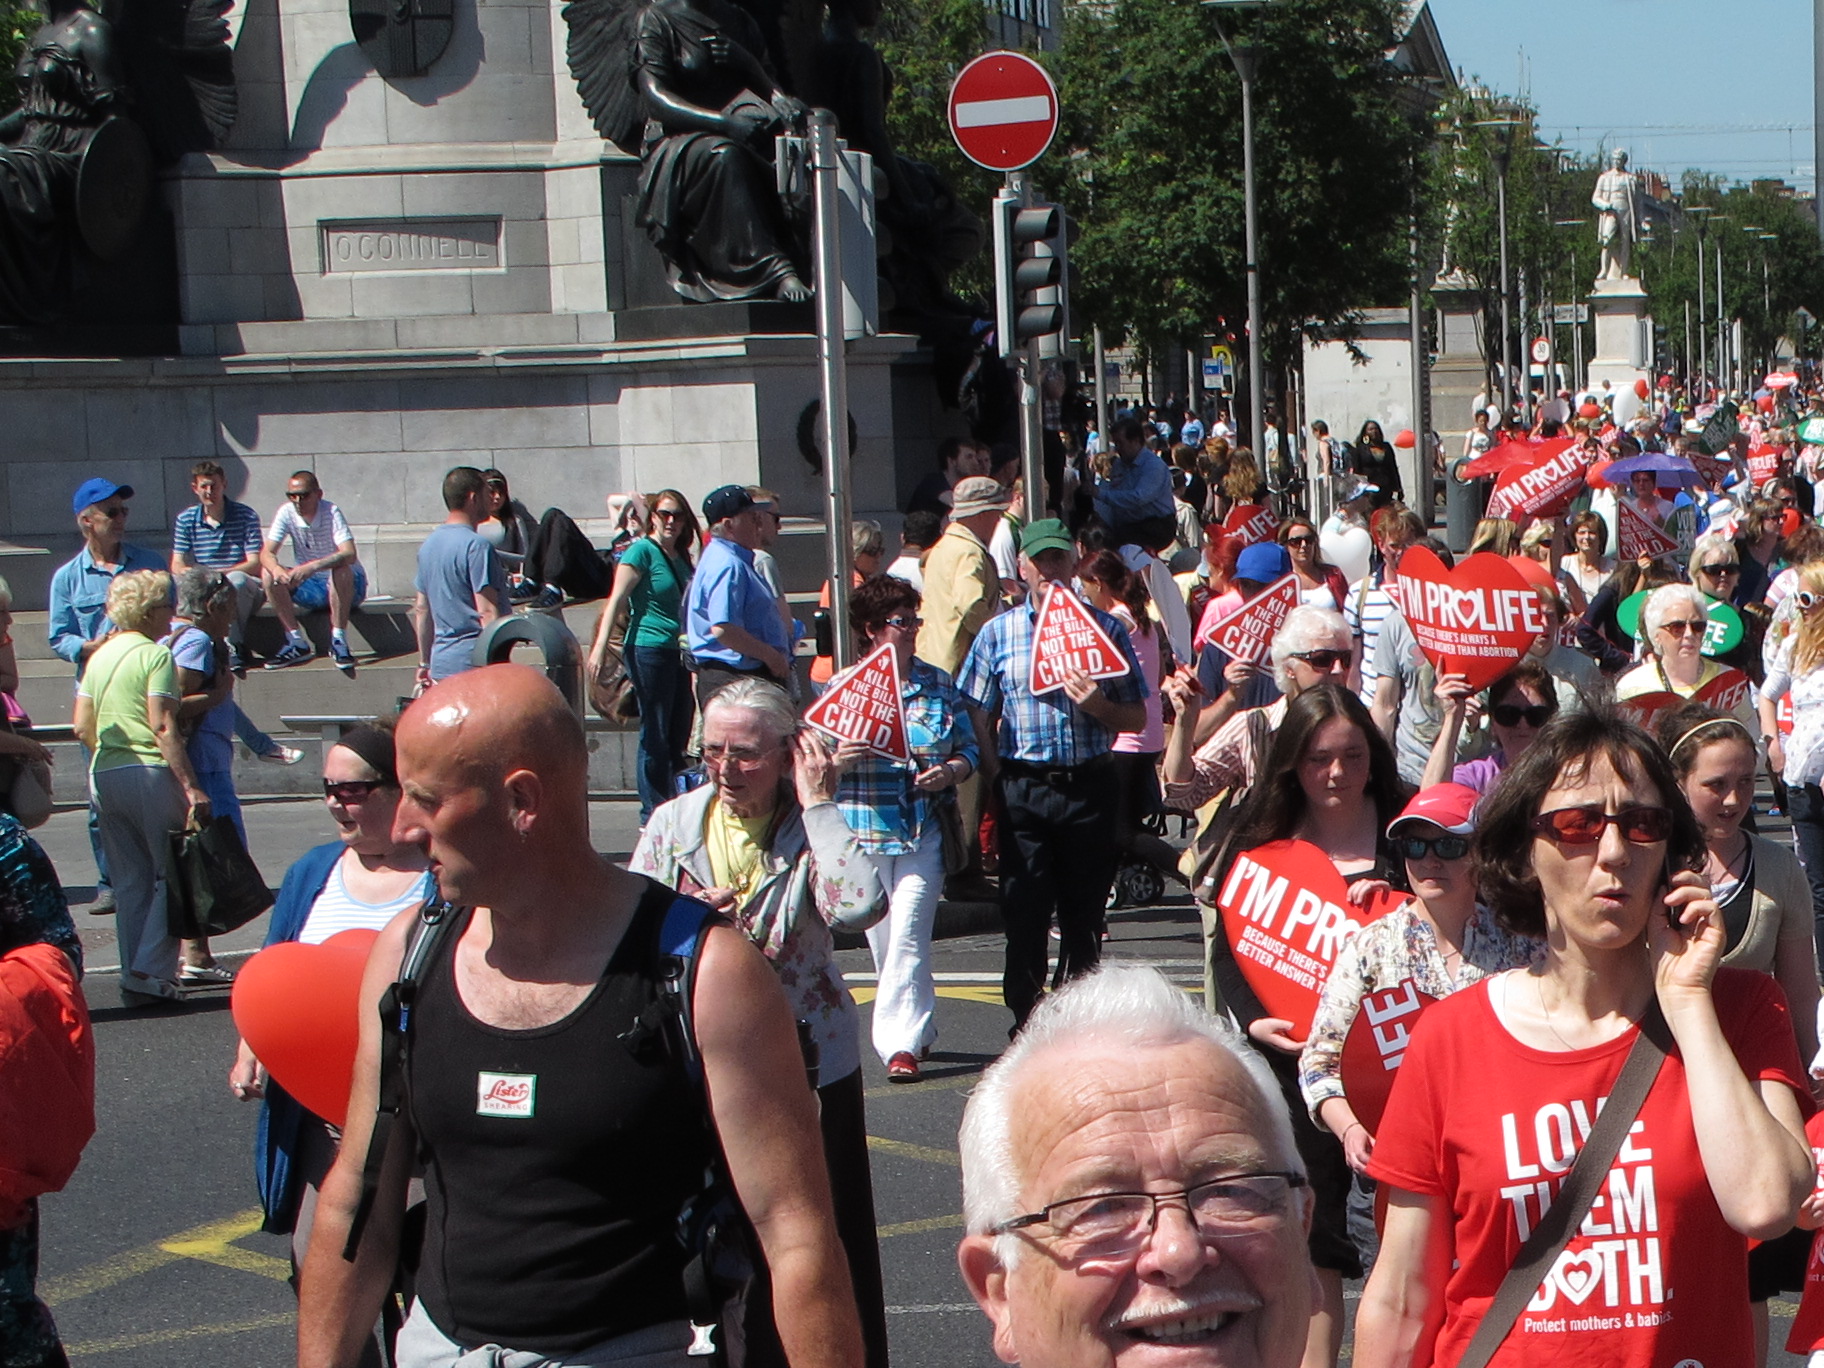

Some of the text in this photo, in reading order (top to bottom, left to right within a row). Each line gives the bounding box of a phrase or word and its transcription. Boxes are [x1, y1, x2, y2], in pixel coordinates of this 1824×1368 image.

[1496, 481, 1528, 511] I'M
[1048, 606, 1077, 625] KILL
[1397, 573, 1544, 633] I'M PROLIFE
[1042, 624, 1063, 639] THE
[1240, 613, 1271, 639] NOT
[1459, 632, 1489, 645] ALWAYS
[1490, 634, 1498, 645] A
[1040, 629, 1097, 656] NOT THE
[1222, 625, 1274, 670] CHIL
[1457, 644, 1478, 657] THAN
[1478, 646, 1519, 658] ABORTION
[851, 678, 870, 696] THE
[863, 668, 891, 691] KILL
[838, 688, 897, 725] NOT THE
[822, 703, 894, 753] CHILD.
[1220, 855, 1290, 929] I'M
[1242, 924, 1329, 979] BECAUSE THERE'S
[1236, 939, 1317, 991] BETTER ANSWER
[483, 1080, 529, 1104] Lister
[1524, 1317, 1566, 1334] Protect
[1569, 1313, 1622, 1331] mothers
[1625, 1312, 1635, 1327] &
